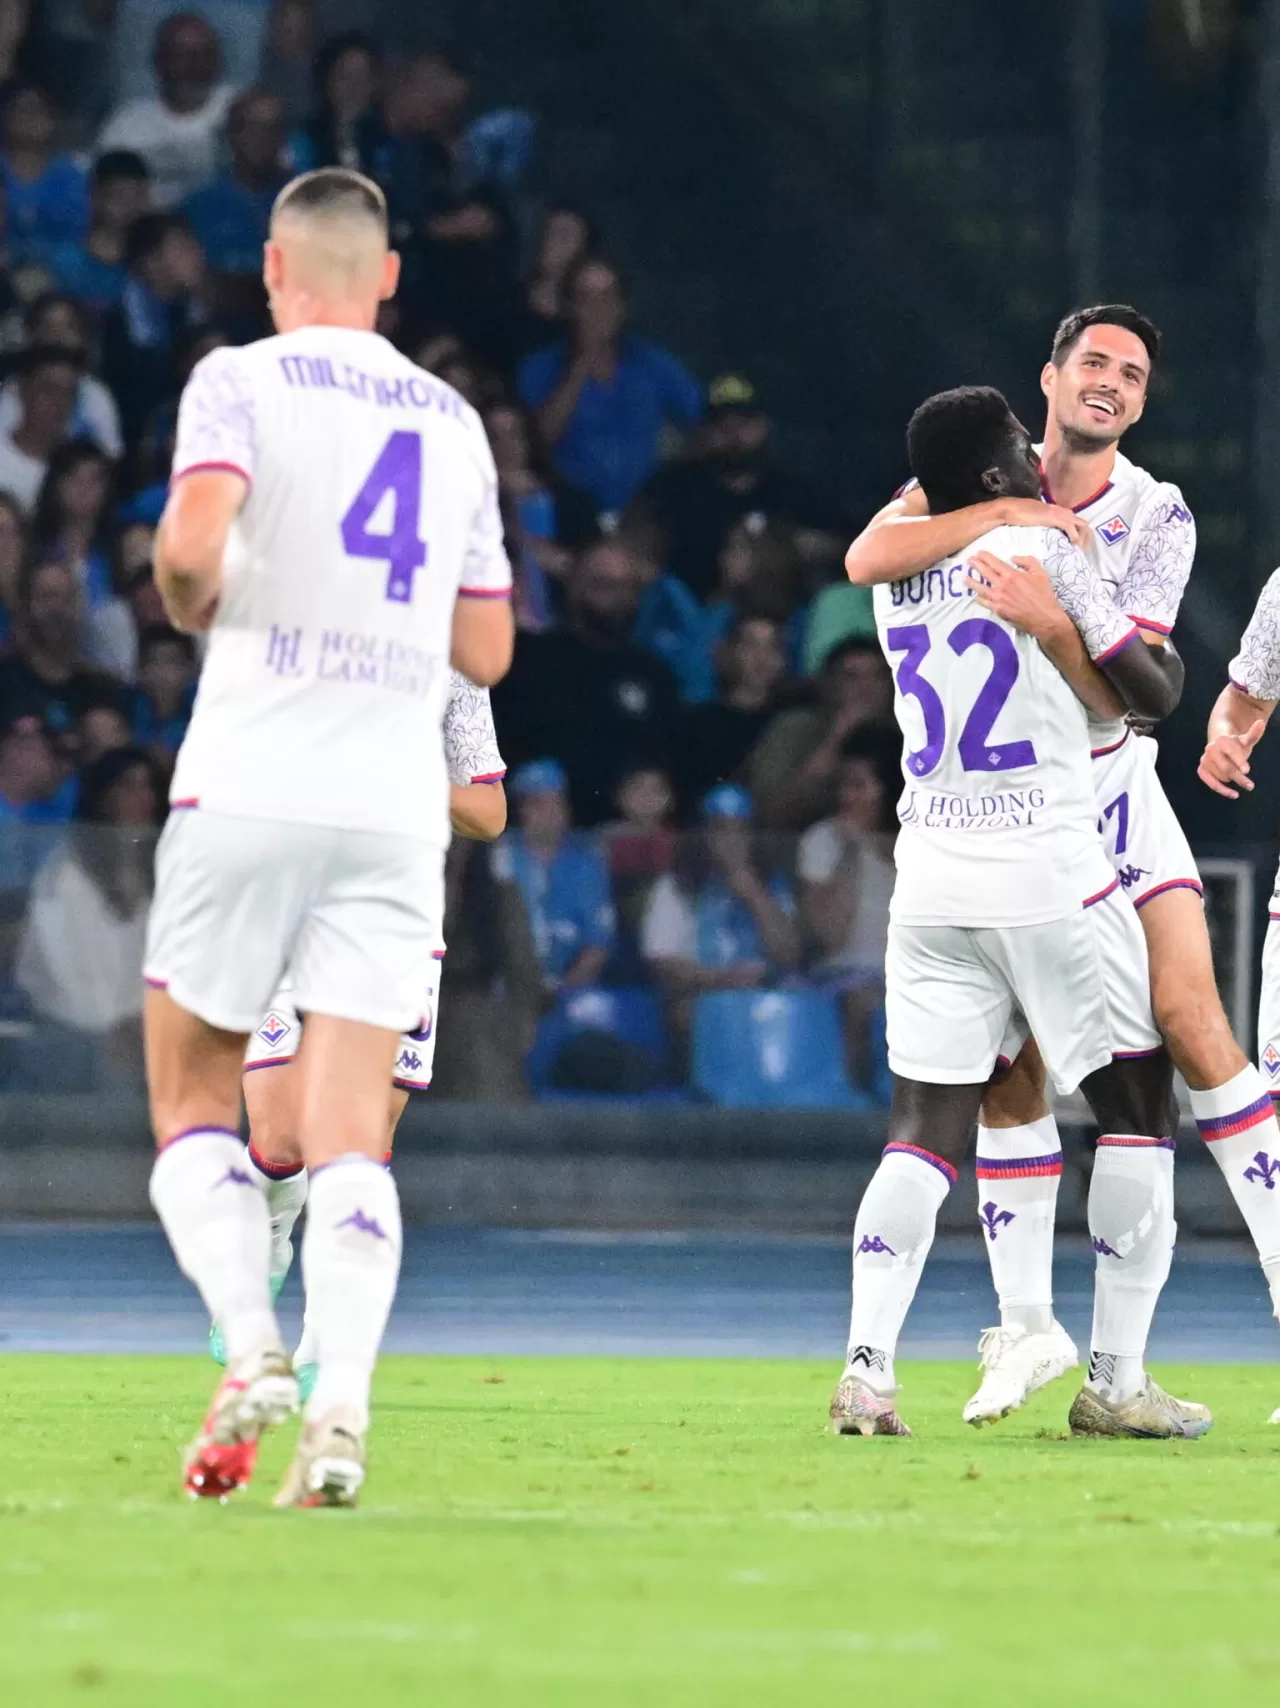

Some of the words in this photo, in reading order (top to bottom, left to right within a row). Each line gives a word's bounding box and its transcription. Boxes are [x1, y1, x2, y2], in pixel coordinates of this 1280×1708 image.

[341, 430, 427, 604] 4
[887, 618, 1037, 777] 32
[929, 788, 1045, 817] HOLDING
